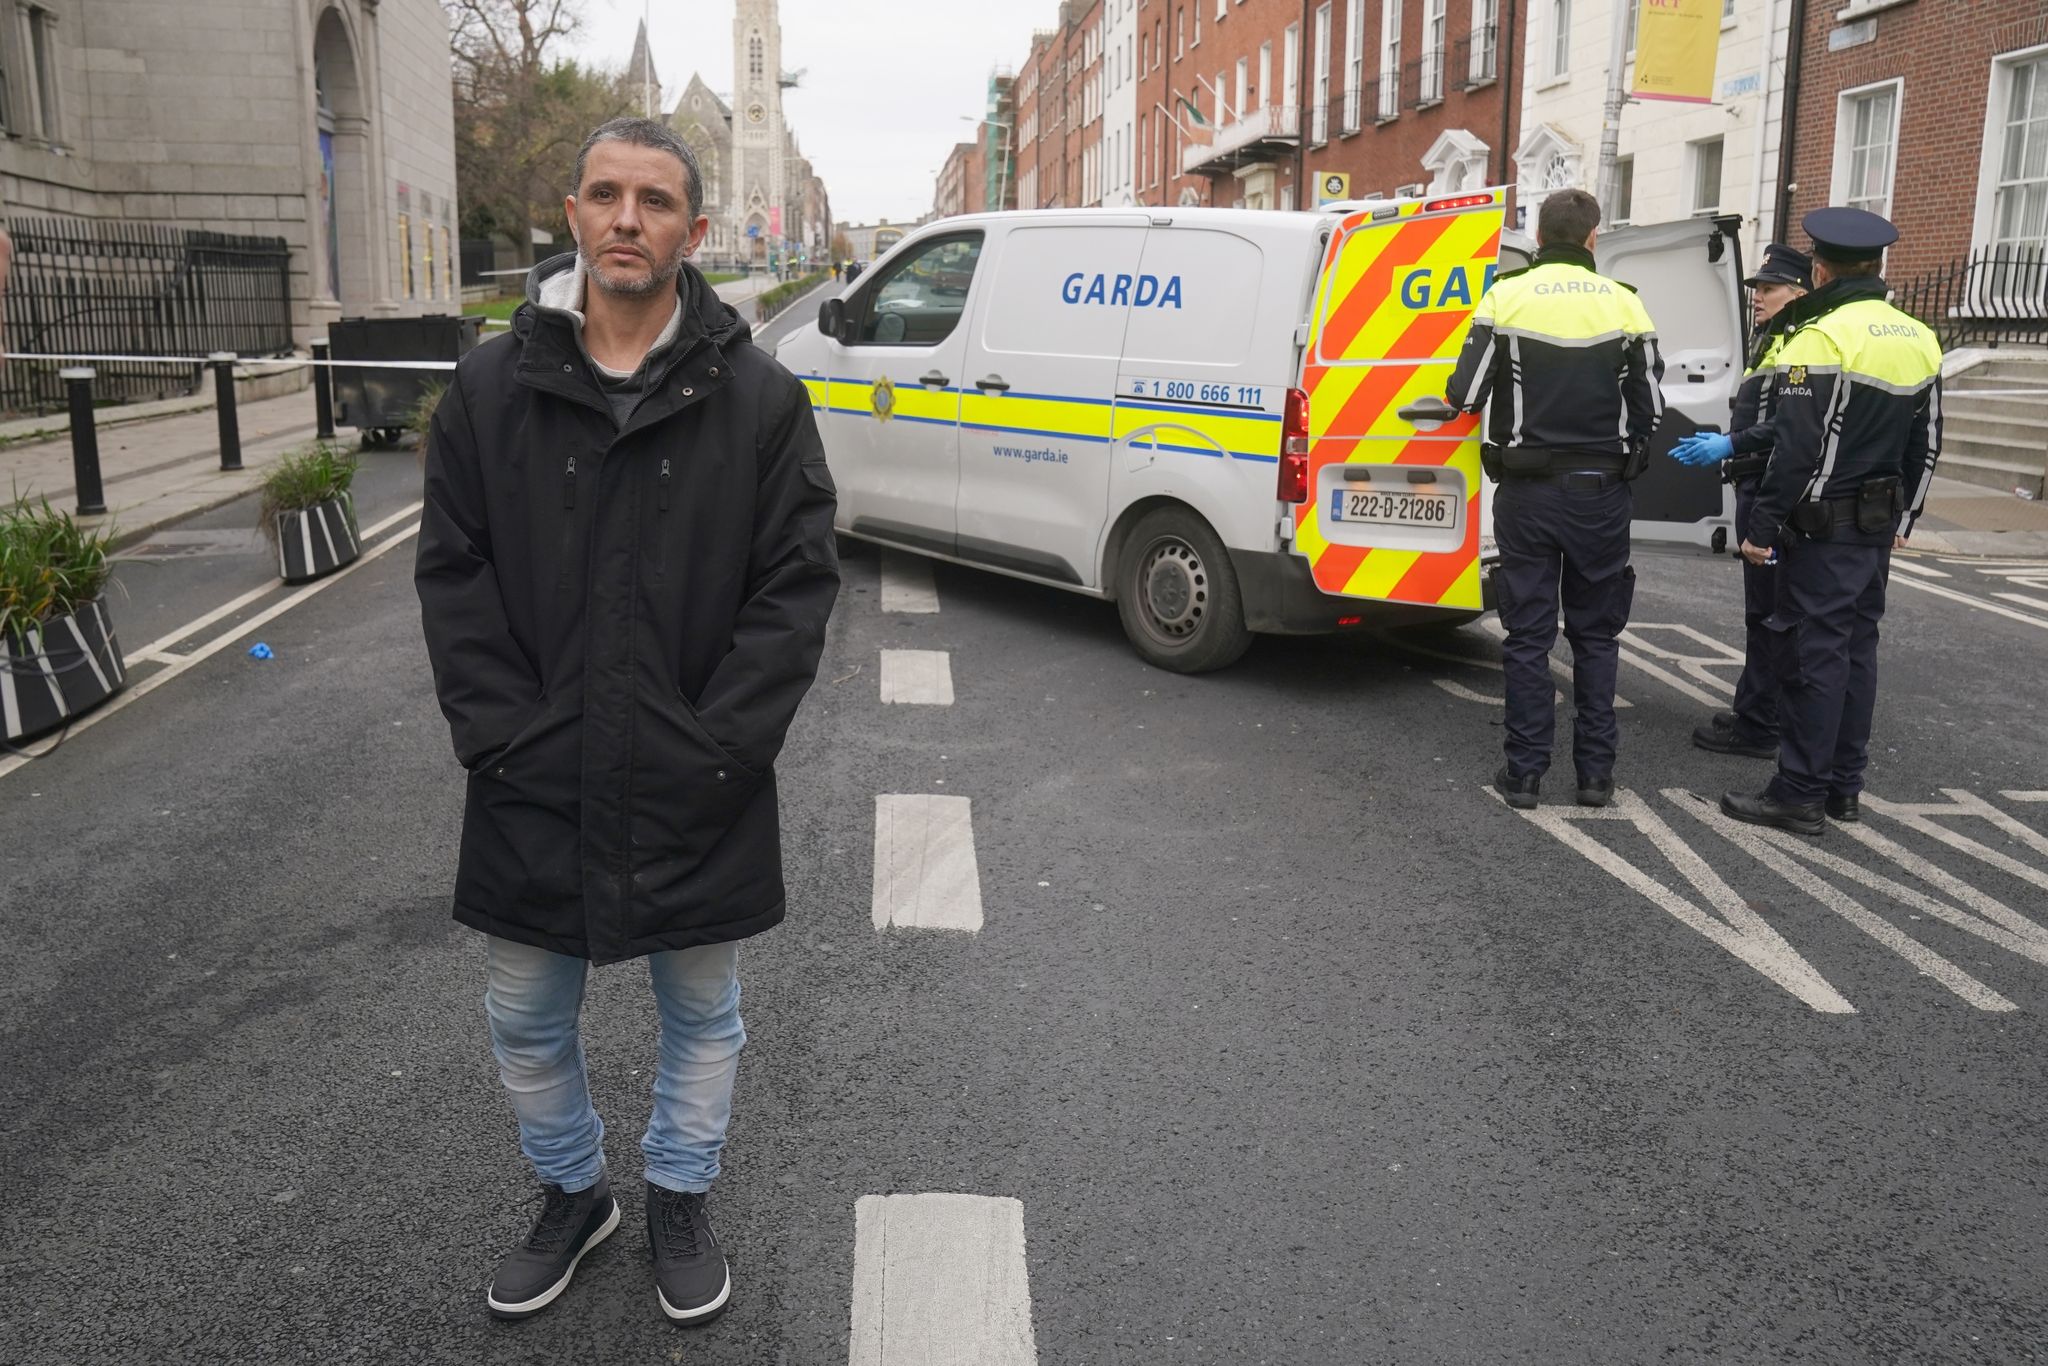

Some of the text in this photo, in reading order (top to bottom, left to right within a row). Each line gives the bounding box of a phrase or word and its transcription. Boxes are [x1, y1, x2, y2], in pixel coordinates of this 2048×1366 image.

[1062, 272, 1182, 309] GARDA
[1534, 281, 1612, 295] GARDA
[1868, 323, 1920, 339] GARDA
[1153, 381, 1262, 405] 1 800 666 111
[1778, 386, 1813, 397] GARDA
[993, 446, 1069, 464] www.garda.ie
[1350, 495, 1446, 522] 222-D-21286
